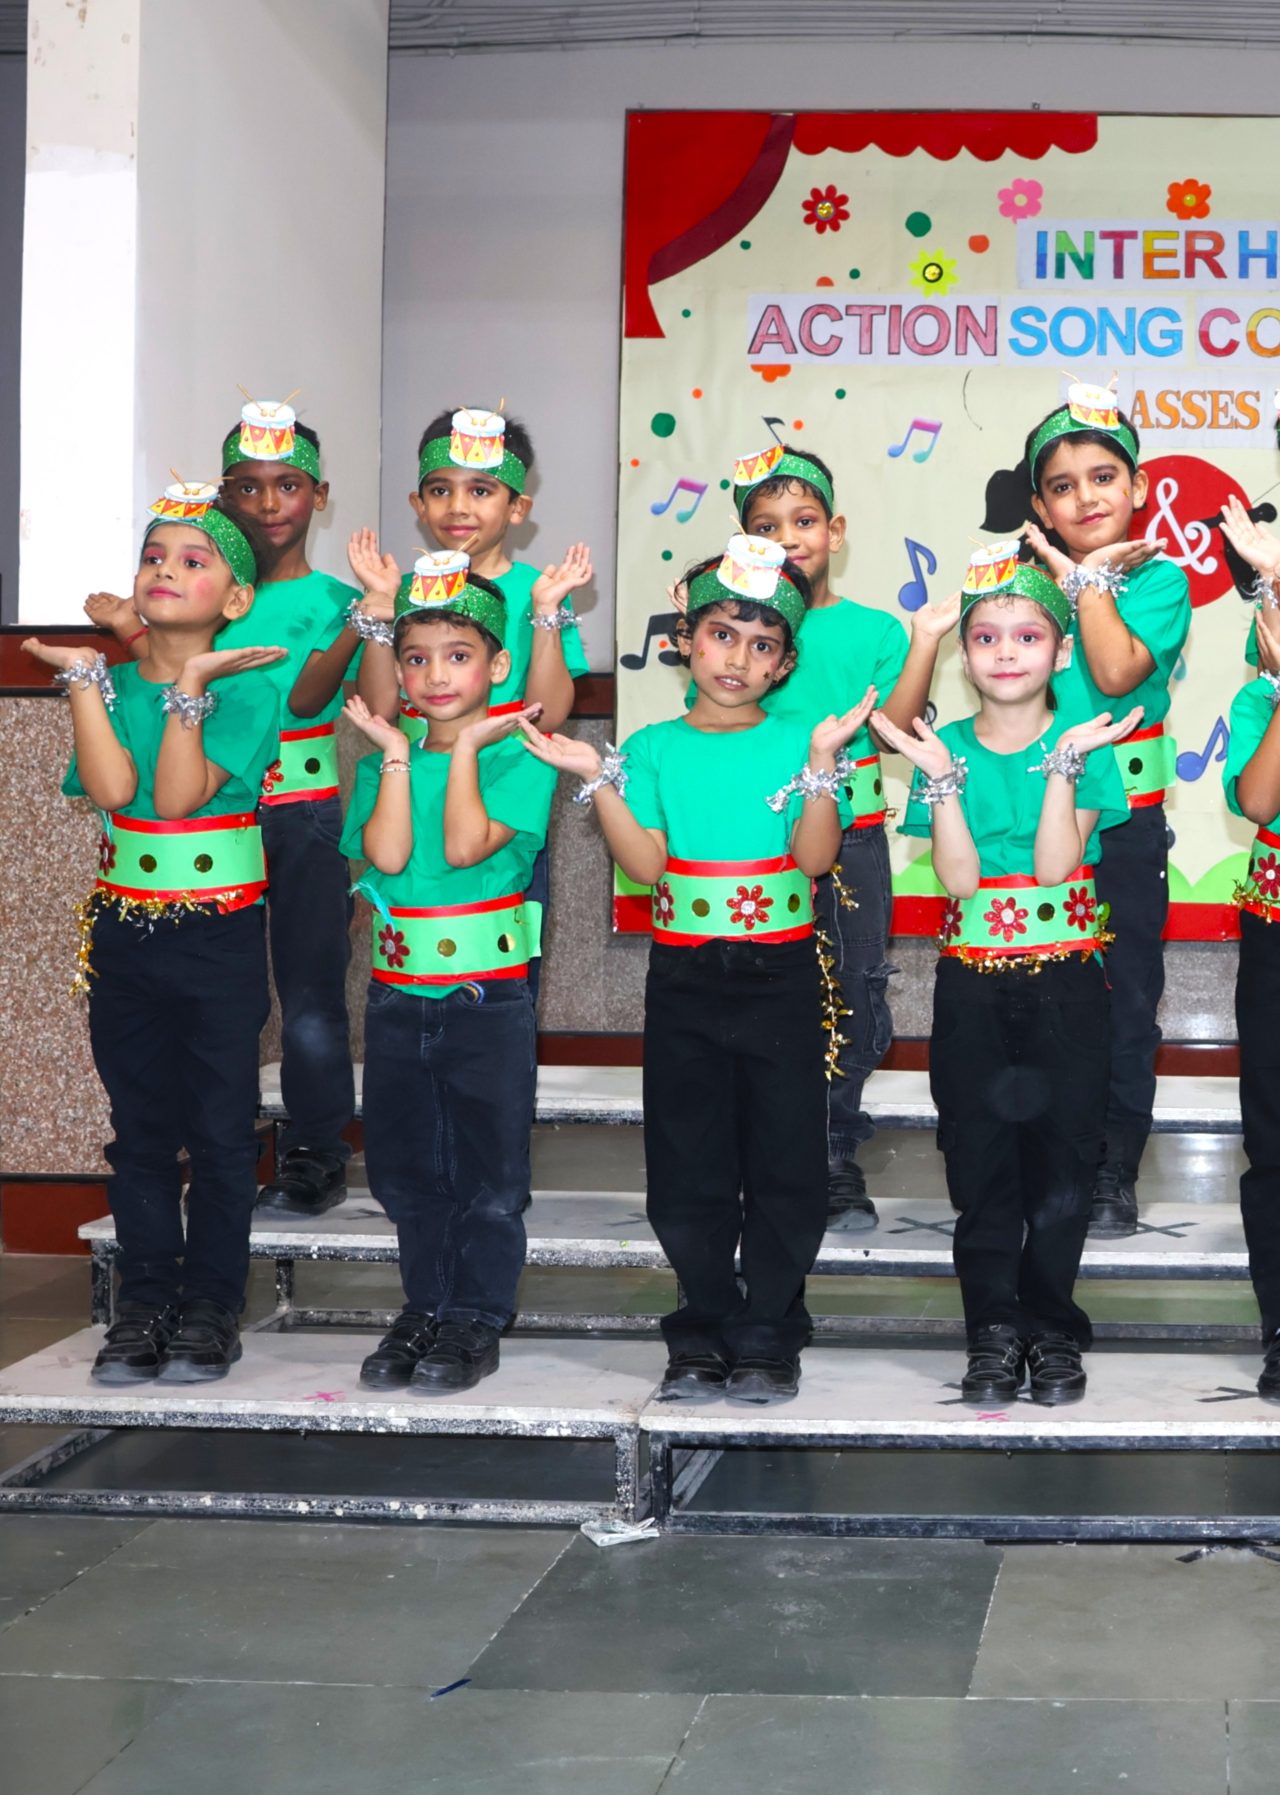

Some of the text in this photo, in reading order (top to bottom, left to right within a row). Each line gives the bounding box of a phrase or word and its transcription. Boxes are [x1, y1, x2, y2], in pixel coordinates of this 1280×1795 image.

[747, 303, 998, 356] ACTION
[1008, 305, 1183, 357] SONG
[1110, 388, 1261, 430] ASSES
